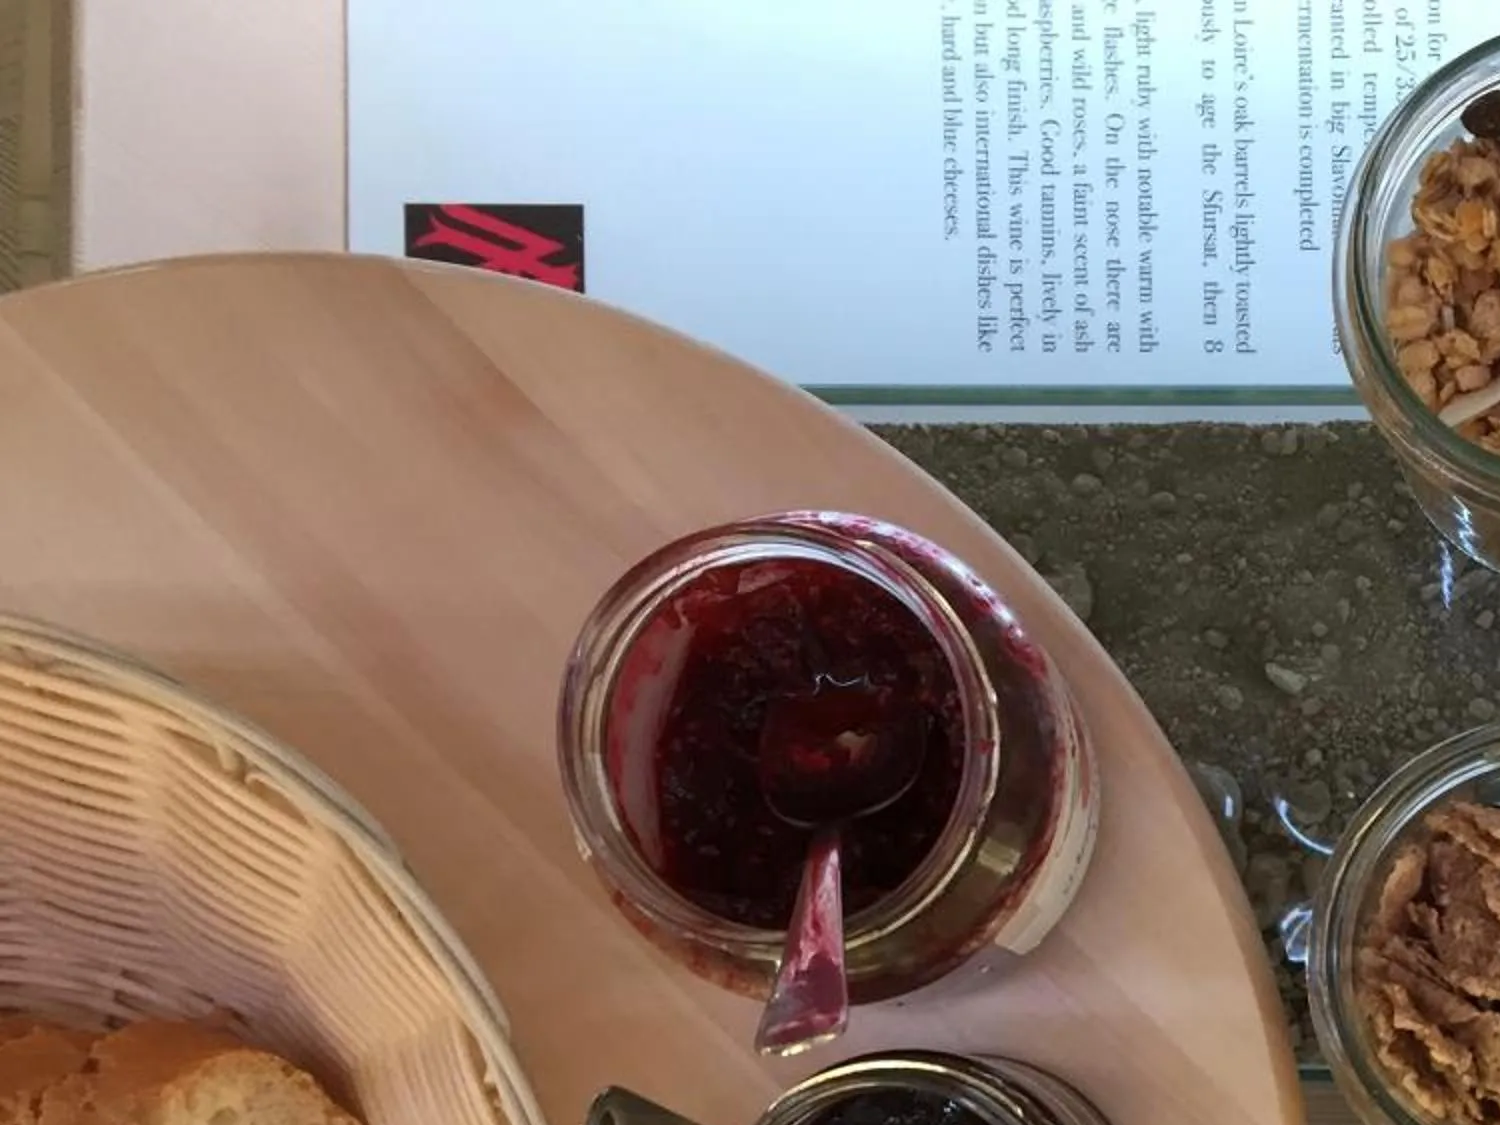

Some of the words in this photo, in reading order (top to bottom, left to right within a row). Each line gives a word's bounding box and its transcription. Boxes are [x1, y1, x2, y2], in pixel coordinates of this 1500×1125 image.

[941, 16, 962, 61] hard
[974, 23, 994, 56] but
[1071, 5, 1093, 40] and
[1130, 12, 1157, 57] light
[1395, 7, 1416, 29] of
[1001, 26, 1028, 73] long
[1072, 48, 1094, 90] wild
[1202, 59, 1218, 79] to
[942, 66, 963, 102] and
[974, 63, 994, 102] also
[1131, 64, 1158, 109] ruby
[1331, 71, 1351, 90] in
[942, 109, 964, 149] blue
[1007, 80, 1028, 141] finish.
[1104, 113, 1126, 145] On
[1196, 93, 1218, 129] age
[1233, 96, 1254, 132] oak
[1300, 125, 1319, 138] is
[1325, 102, 1351, 133] big
[1040, 119, 1061, 176] Good
[1137, 118, 1159, 160] with
[1202, 143, 1223, 174] the
[975, 110, 997, 239] international
[1007, 150, 1030, 195] This
[1105, 157, 1127, 187] the
[1233, 139, 1255, 208] barrels
[943, 158, 964, 241] cheeses.
[1072, 183, 1094, 226] faint
[1137, 168, 1159, 242] notable
[1293, 145, 1321, 250] completed
[1009, 202, 1028, 250] wine
[1106, 201, 1121, 248] nose
[1227, 213, 1255, 274] lightly
[976, 246, 998, 309] dishes
[1009, 259, 1029, 274] is
[1073, 233, 1092, 286] scent
[1138, 250, 1154, 302] warm
[1036, 273, 1063, 326] lively
[1073, 294, 1095, 313] of
[1107, 258, 1127, 311] there
[1202, 281, 1224, 325] then
[977, 316, 998, 352] like
[1004, 282, 1030, 352] perfect
[1074, 320, 1095, 353] ash
[1107, 321, 1122, 353] are
[1138, 310, 1160, 353] with
[1234, 282, 1256, 353] toasted
[1042, 334, 1062, 353] in
[1203, 340, 1224, 353] 8
